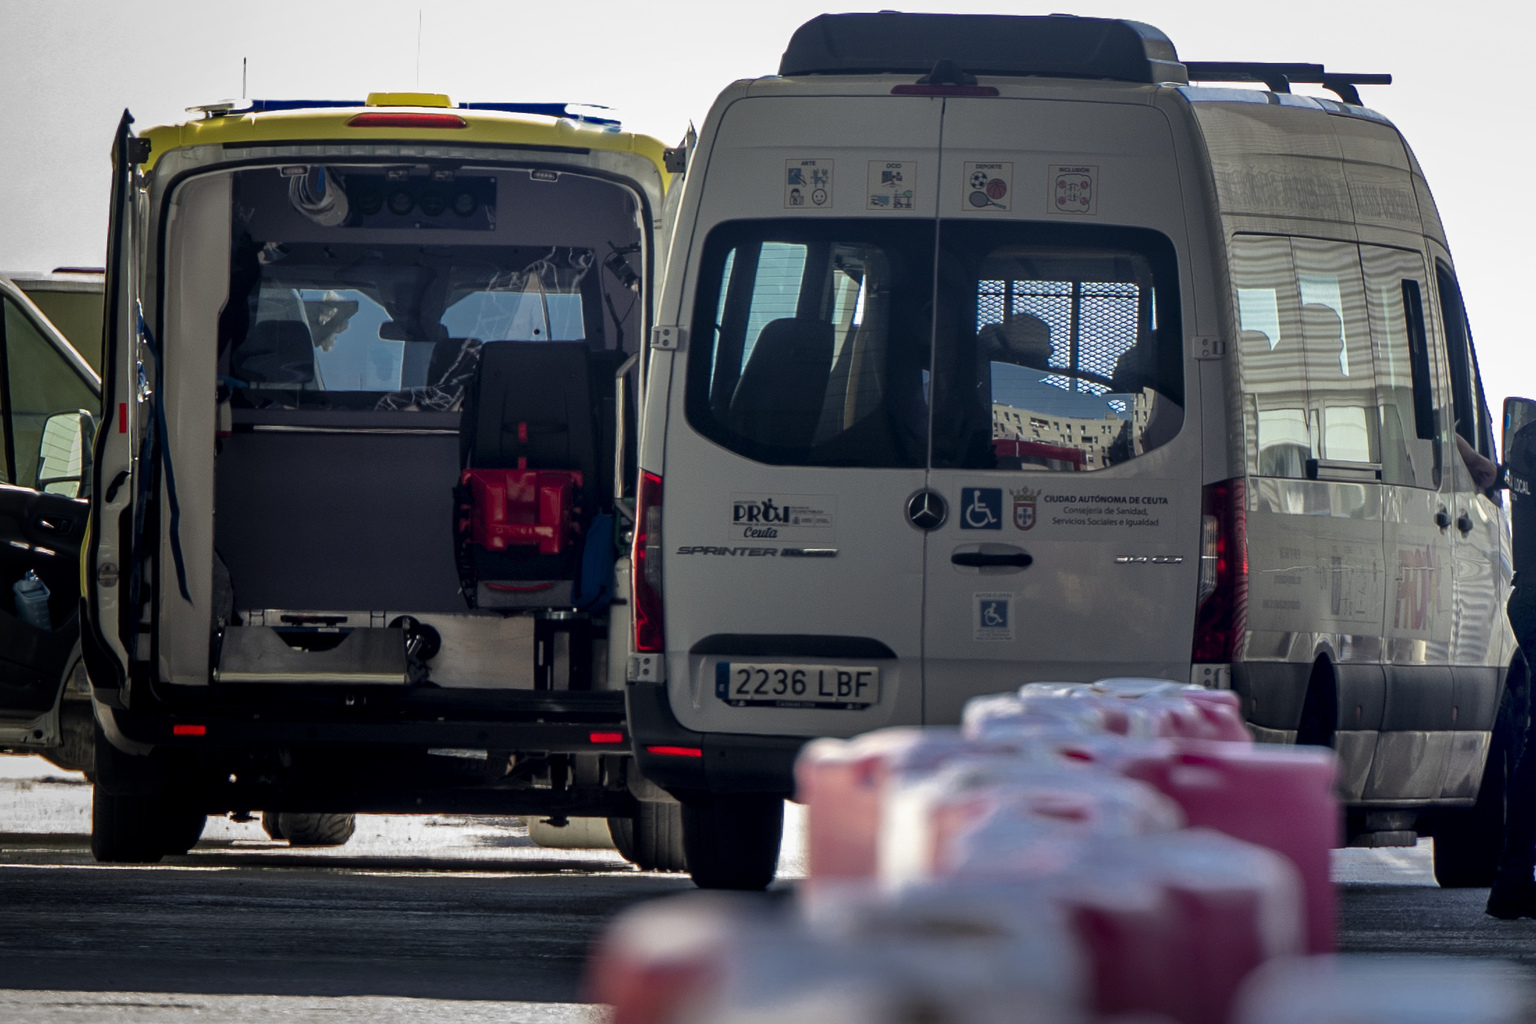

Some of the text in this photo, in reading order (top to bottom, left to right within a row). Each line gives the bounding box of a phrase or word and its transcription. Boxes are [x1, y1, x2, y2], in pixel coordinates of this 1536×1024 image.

[1059, 166, 1090, 174] INCLUSIÓN
[1044, 494, 1169, 505] CIUDAD AUTÓNOMA DE CEUTA
[1105, 507, 1114, 515] de
[1116, 507, 1149, 516] Sanidad,
[1052, 517, 1086, 525] Servicios
[1087, 517, 1118, 526] Sociales
[1125, 518, 1159, 528] Igualdad
[743, 527, 778, 539] Ceuta
[676, 546, 778, 557] SPRINTER
[736, 669, 873, 697] 2236 LBF
